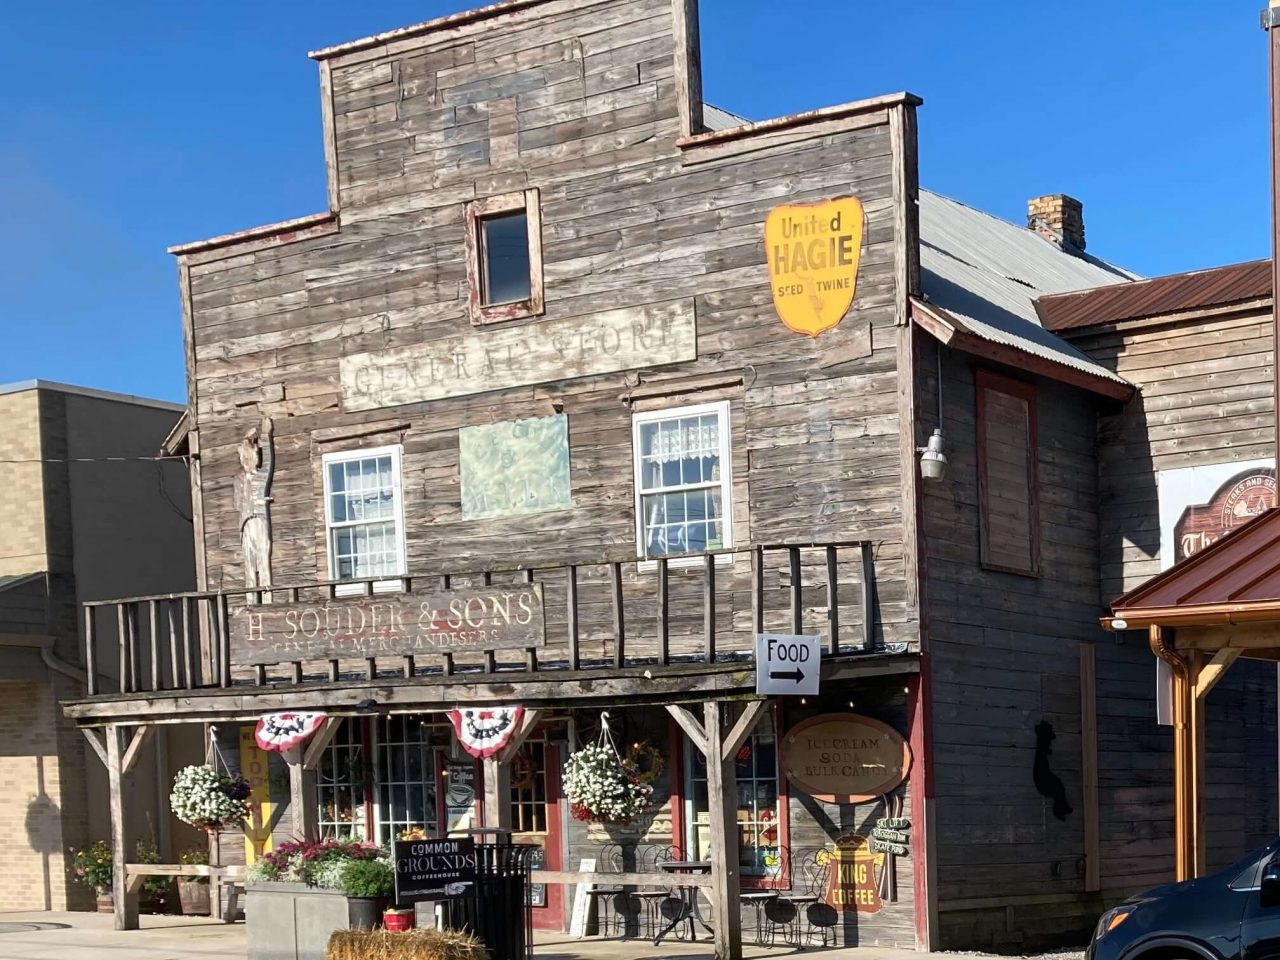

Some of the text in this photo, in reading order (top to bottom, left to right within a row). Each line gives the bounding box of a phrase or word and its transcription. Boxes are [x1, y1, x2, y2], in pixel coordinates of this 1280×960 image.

[781, 211, 841, 239] United
[774, 235, 853, 275] HAGIE
[816, 278, 850, 292] TWINE
[354, 344, 534, 395] GENERAL
[1224, 484, 1245, 515] STEAKS
[1246, 478, 1262, 488] AND
[418, 602, 440, 631] &
[447, 593, 533, 629] SONS
[767, 639, 810, 662] FOOD
[833, 739, 880, 750] CREAM
[819, 753, 861, 764] SODA
[411, 842, 458, 855] COMMON
[397, 854, 475, 872] GROUNDS
[837, 863, 867, 884] KING
[832, 889, 874, 905] COFFEE
